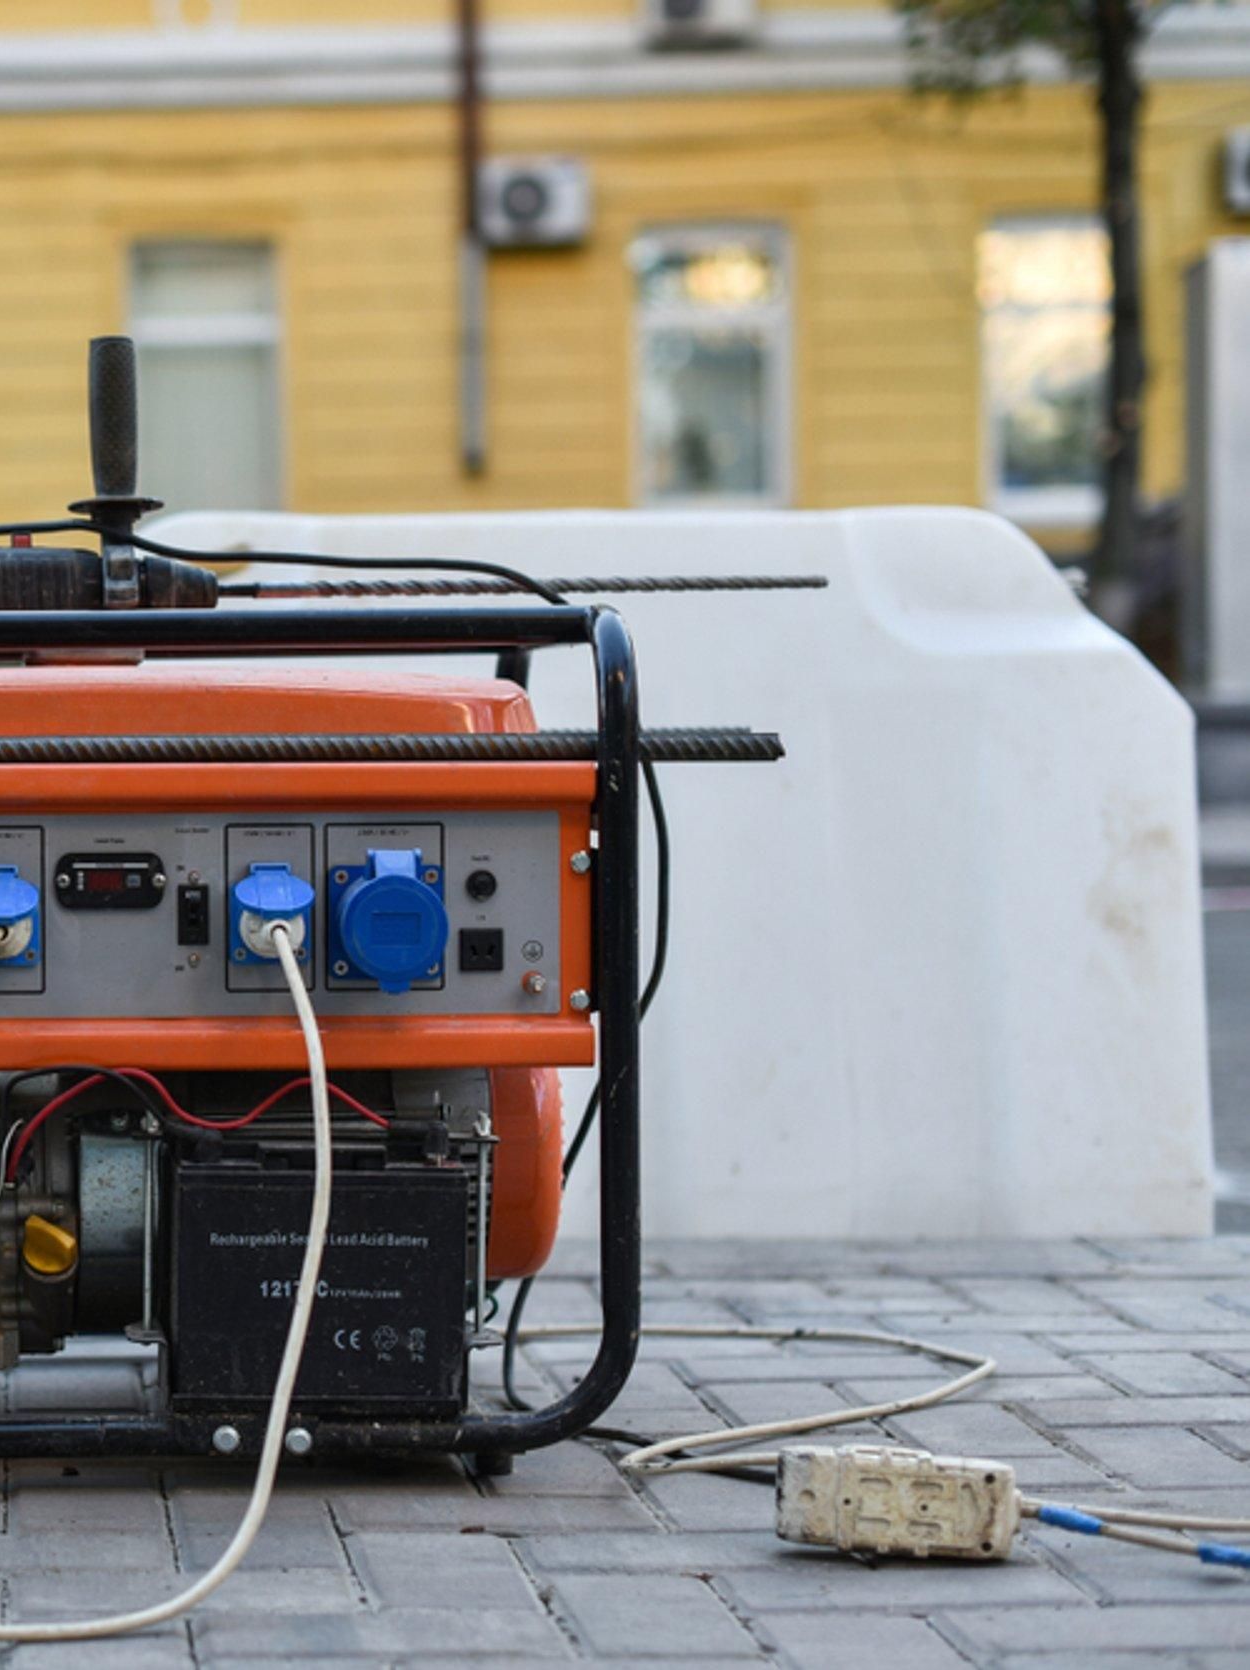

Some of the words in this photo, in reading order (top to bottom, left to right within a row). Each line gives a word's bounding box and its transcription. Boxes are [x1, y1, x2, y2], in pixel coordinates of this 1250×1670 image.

[210, 1232, 287, 1248] Rechargeable
[330, 1233, 358, 1246] Lead
[359, 1233, 386, 1246] Acid
[386, 1233, 430, 1248] Battery
